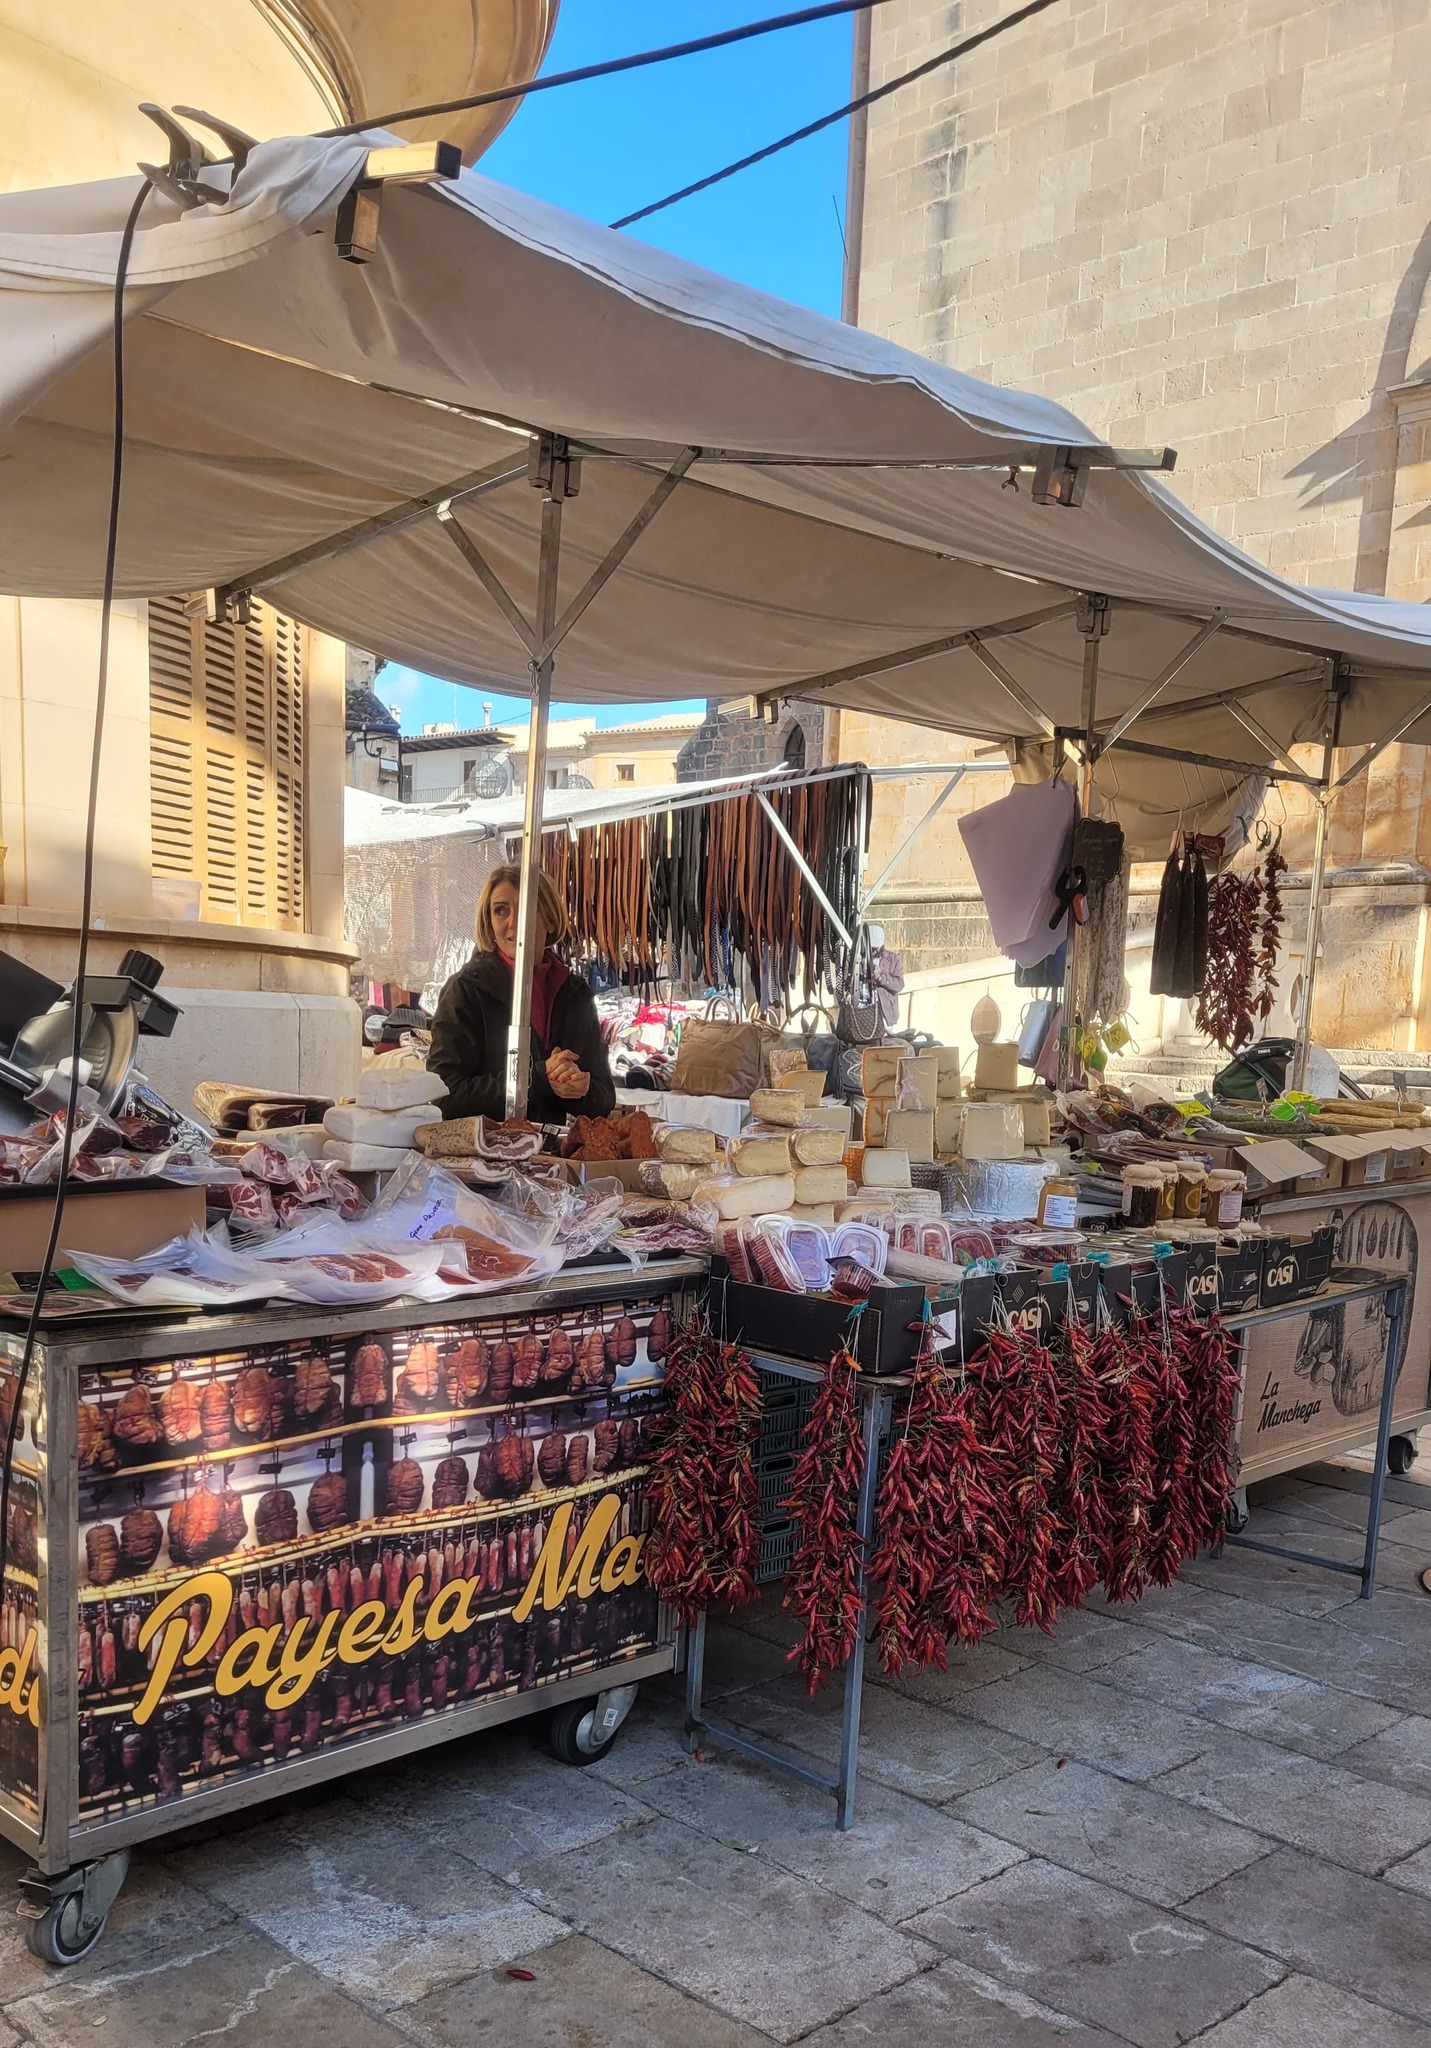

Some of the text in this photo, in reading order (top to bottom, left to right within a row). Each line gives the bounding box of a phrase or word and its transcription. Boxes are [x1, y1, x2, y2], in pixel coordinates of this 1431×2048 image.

[1188, 1275, 1217, 1296] CASI
[1266, 1264, 1294, 1288] CASI
[1008, 1306, 1042, 1331] CASI
[1260, 1371, 1280, 1401] La
[1257, 1400, 1322, 1433] Manchega
[132, 1569, 482, 1725] Payesa
